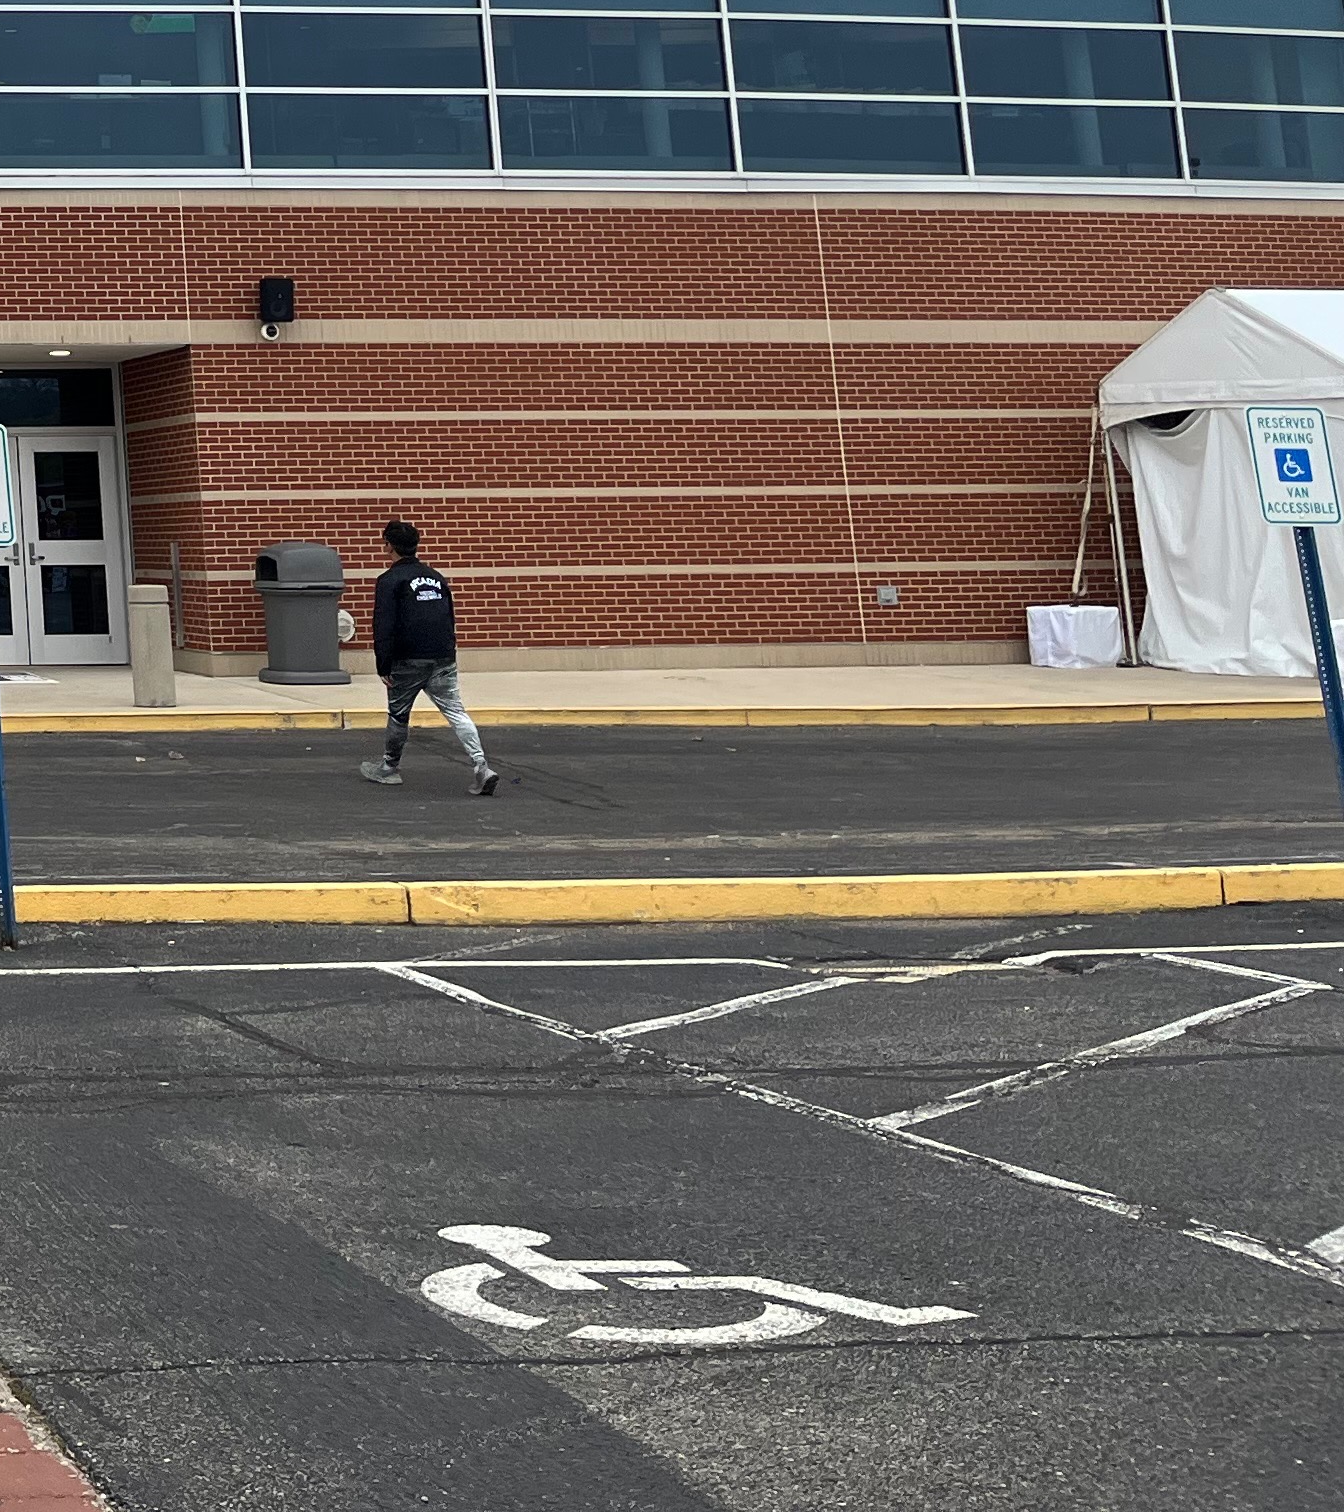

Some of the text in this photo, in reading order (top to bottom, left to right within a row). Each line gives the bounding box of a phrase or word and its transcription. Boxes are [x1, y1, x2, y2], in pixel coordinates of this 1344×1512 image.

[1257, 417, 1315, 429] RESERVED
[1264, 432, 1314, 444] PARKING
[1286, 487, 1310, 498] VAN
[1267, 502, 1336, 514] ACCESSIBLE
